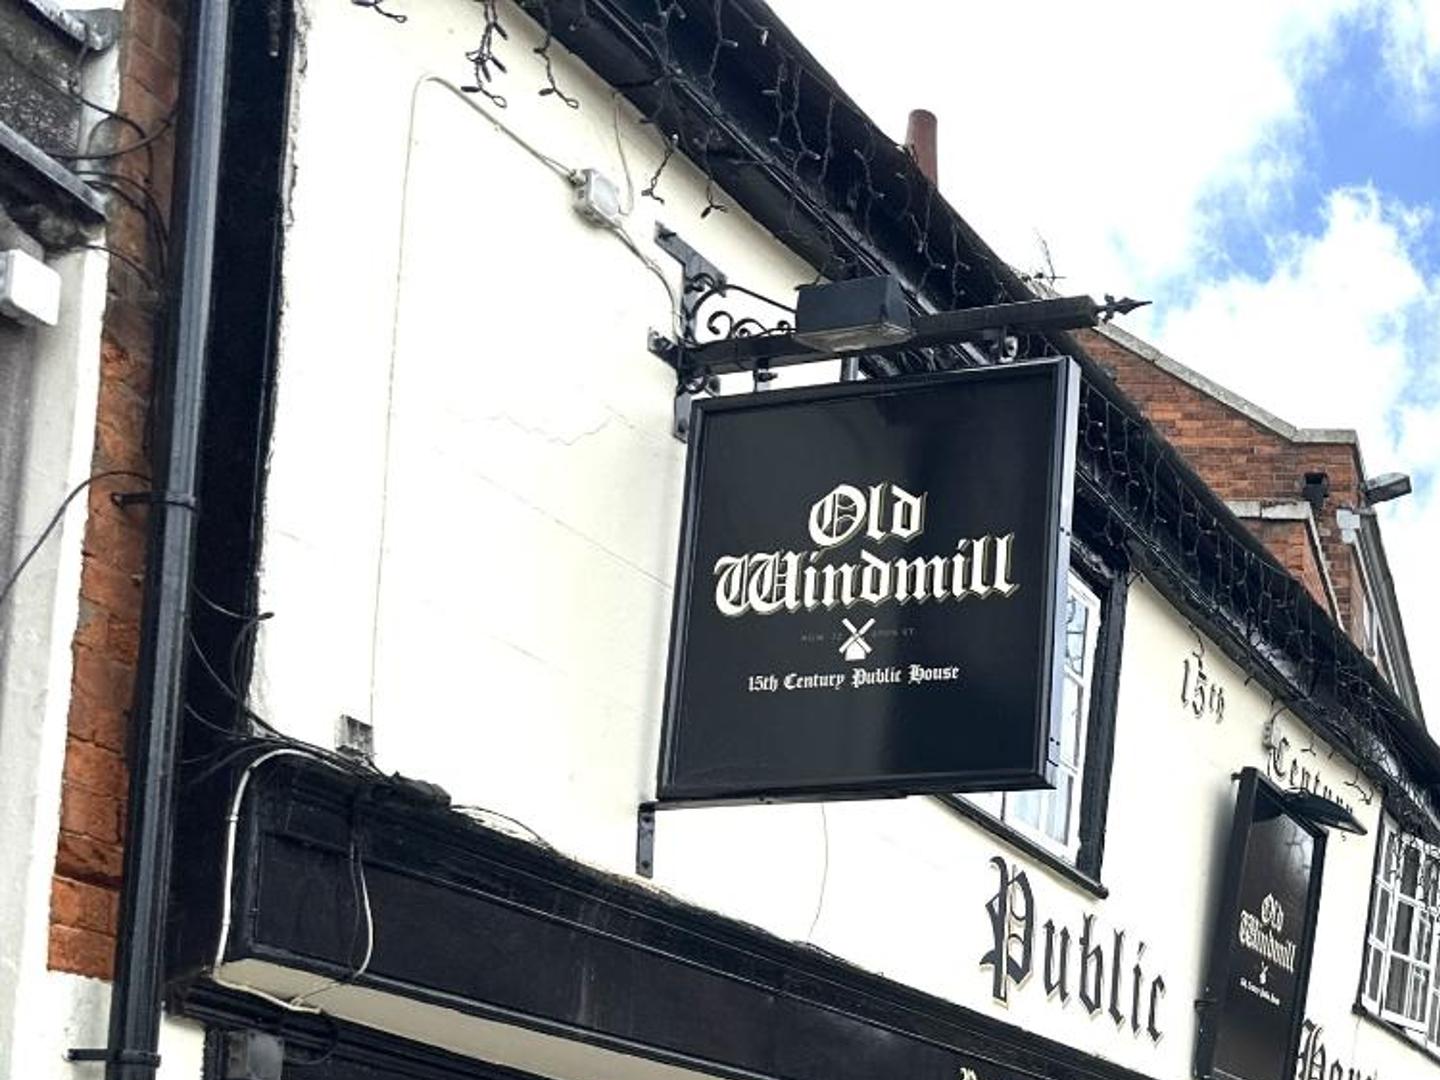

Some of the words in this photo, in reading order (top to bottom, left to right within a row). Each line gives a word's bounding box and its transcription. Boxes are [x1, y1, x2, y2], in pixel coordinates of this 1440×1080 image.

[808, 482, 926, 548] Old
[713, 532, 1019, 616] Windmill
[749, 675, 778, 692] 15th
[784, 673, 845, 690] Century
[852, 667, 902, 688] Public
[908, 664, 960, 685] House
[1239, 909, 1297, 974] Windmill
[1261, 893, 1284, 932] Old
[979, 856, 1167, 1044] Public
